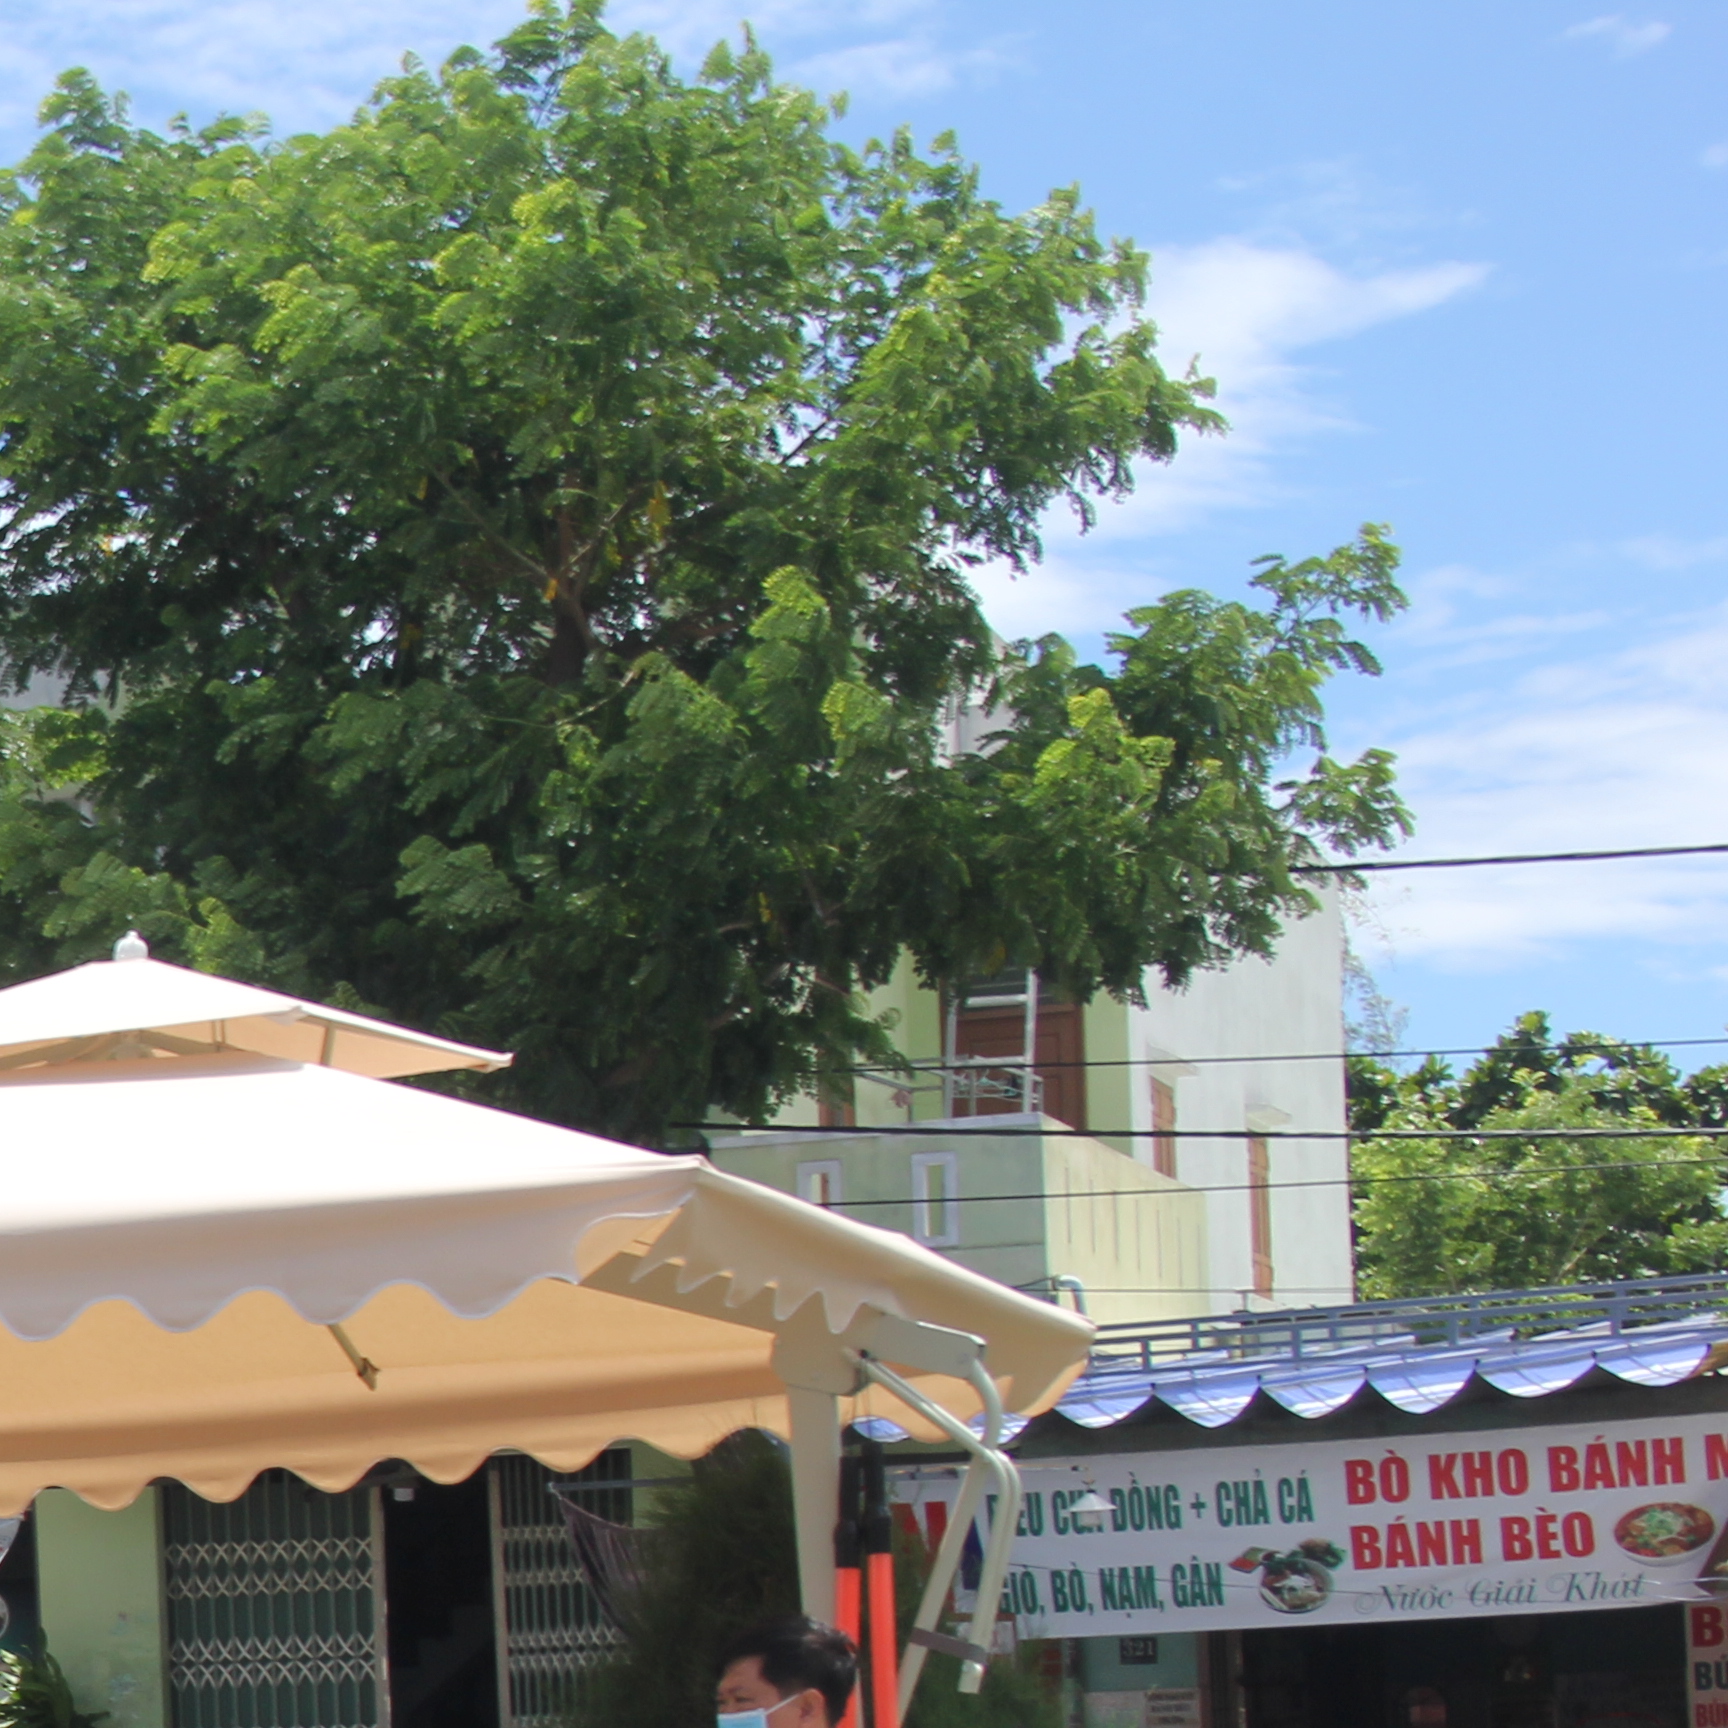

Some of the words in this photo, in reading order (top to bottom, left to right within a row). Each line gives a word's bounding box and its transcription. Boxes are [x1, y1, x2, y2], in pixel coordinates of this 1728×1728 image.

[1215, 1469, 1268, 1527] CHẢ
[1278, 1469, 1316, 1525] CÁ
[1344, 1449, 1411, 1505] BÒ
[1428, 1447, 1530, 1500] KHO
[1547, 1435, 1686, 1493] BÁNH
[1350, 1515, 1483, 1571] BÁNH
[1499, 1506, 1596, 1562] BÈO
